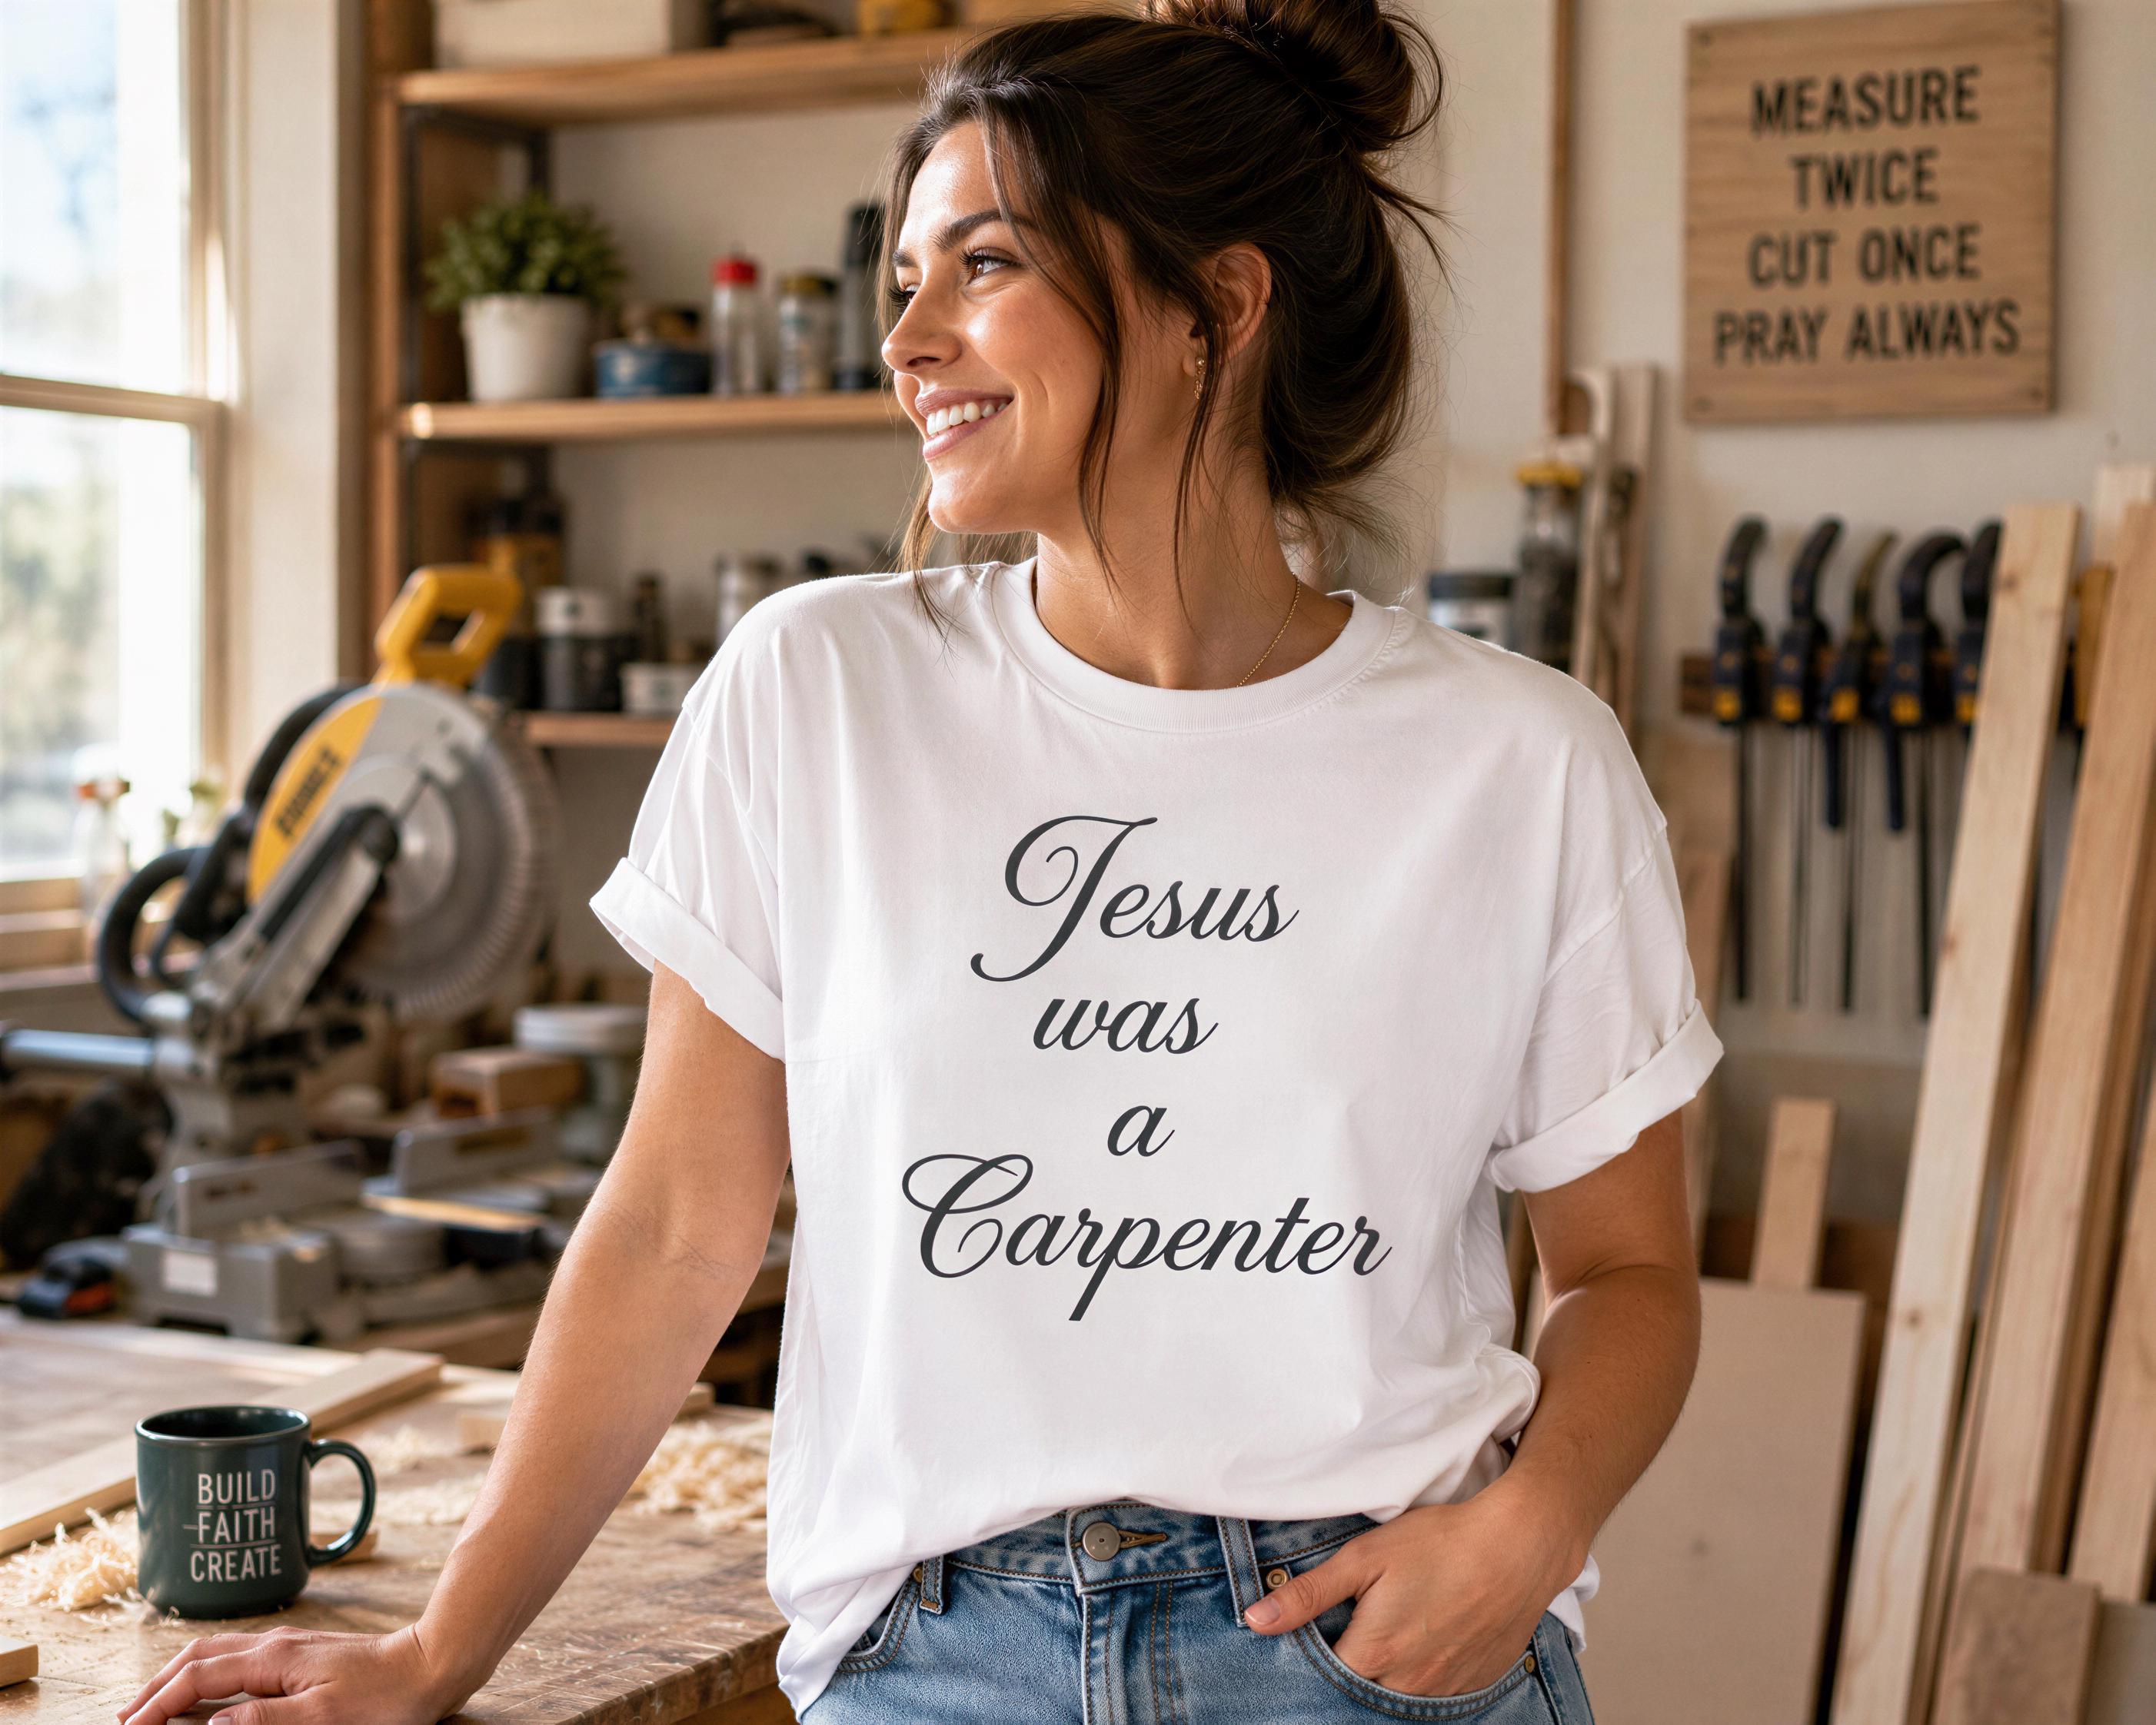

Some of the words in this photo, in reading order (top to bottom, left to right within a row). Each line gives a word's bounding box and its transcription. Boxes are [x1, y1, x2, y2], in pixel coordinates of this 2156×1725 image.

[1752, 65, 1980, 134] MEASURE
[1792, 147, 1938, 207] TWICE
[1749, 231, 1836, 288] CUT
[1860, 225, 1979, 282] ONCE
[1715, 306, 1829, 364] PRAY
[1845, 299, 2020, 361] ALWAYS
[970, 816, 1299, 982] Jesus
[1033, 998, 1219, 1055] was
[1107, 1105, 1175, 1157] a
[902, 1153, 1392, 1321] Carpenter
[198, 1468, 275, 1504] BUILD
[198, 1506, 275, 1544] FAITH
[190, 1544, 282, 1583] CREATE
